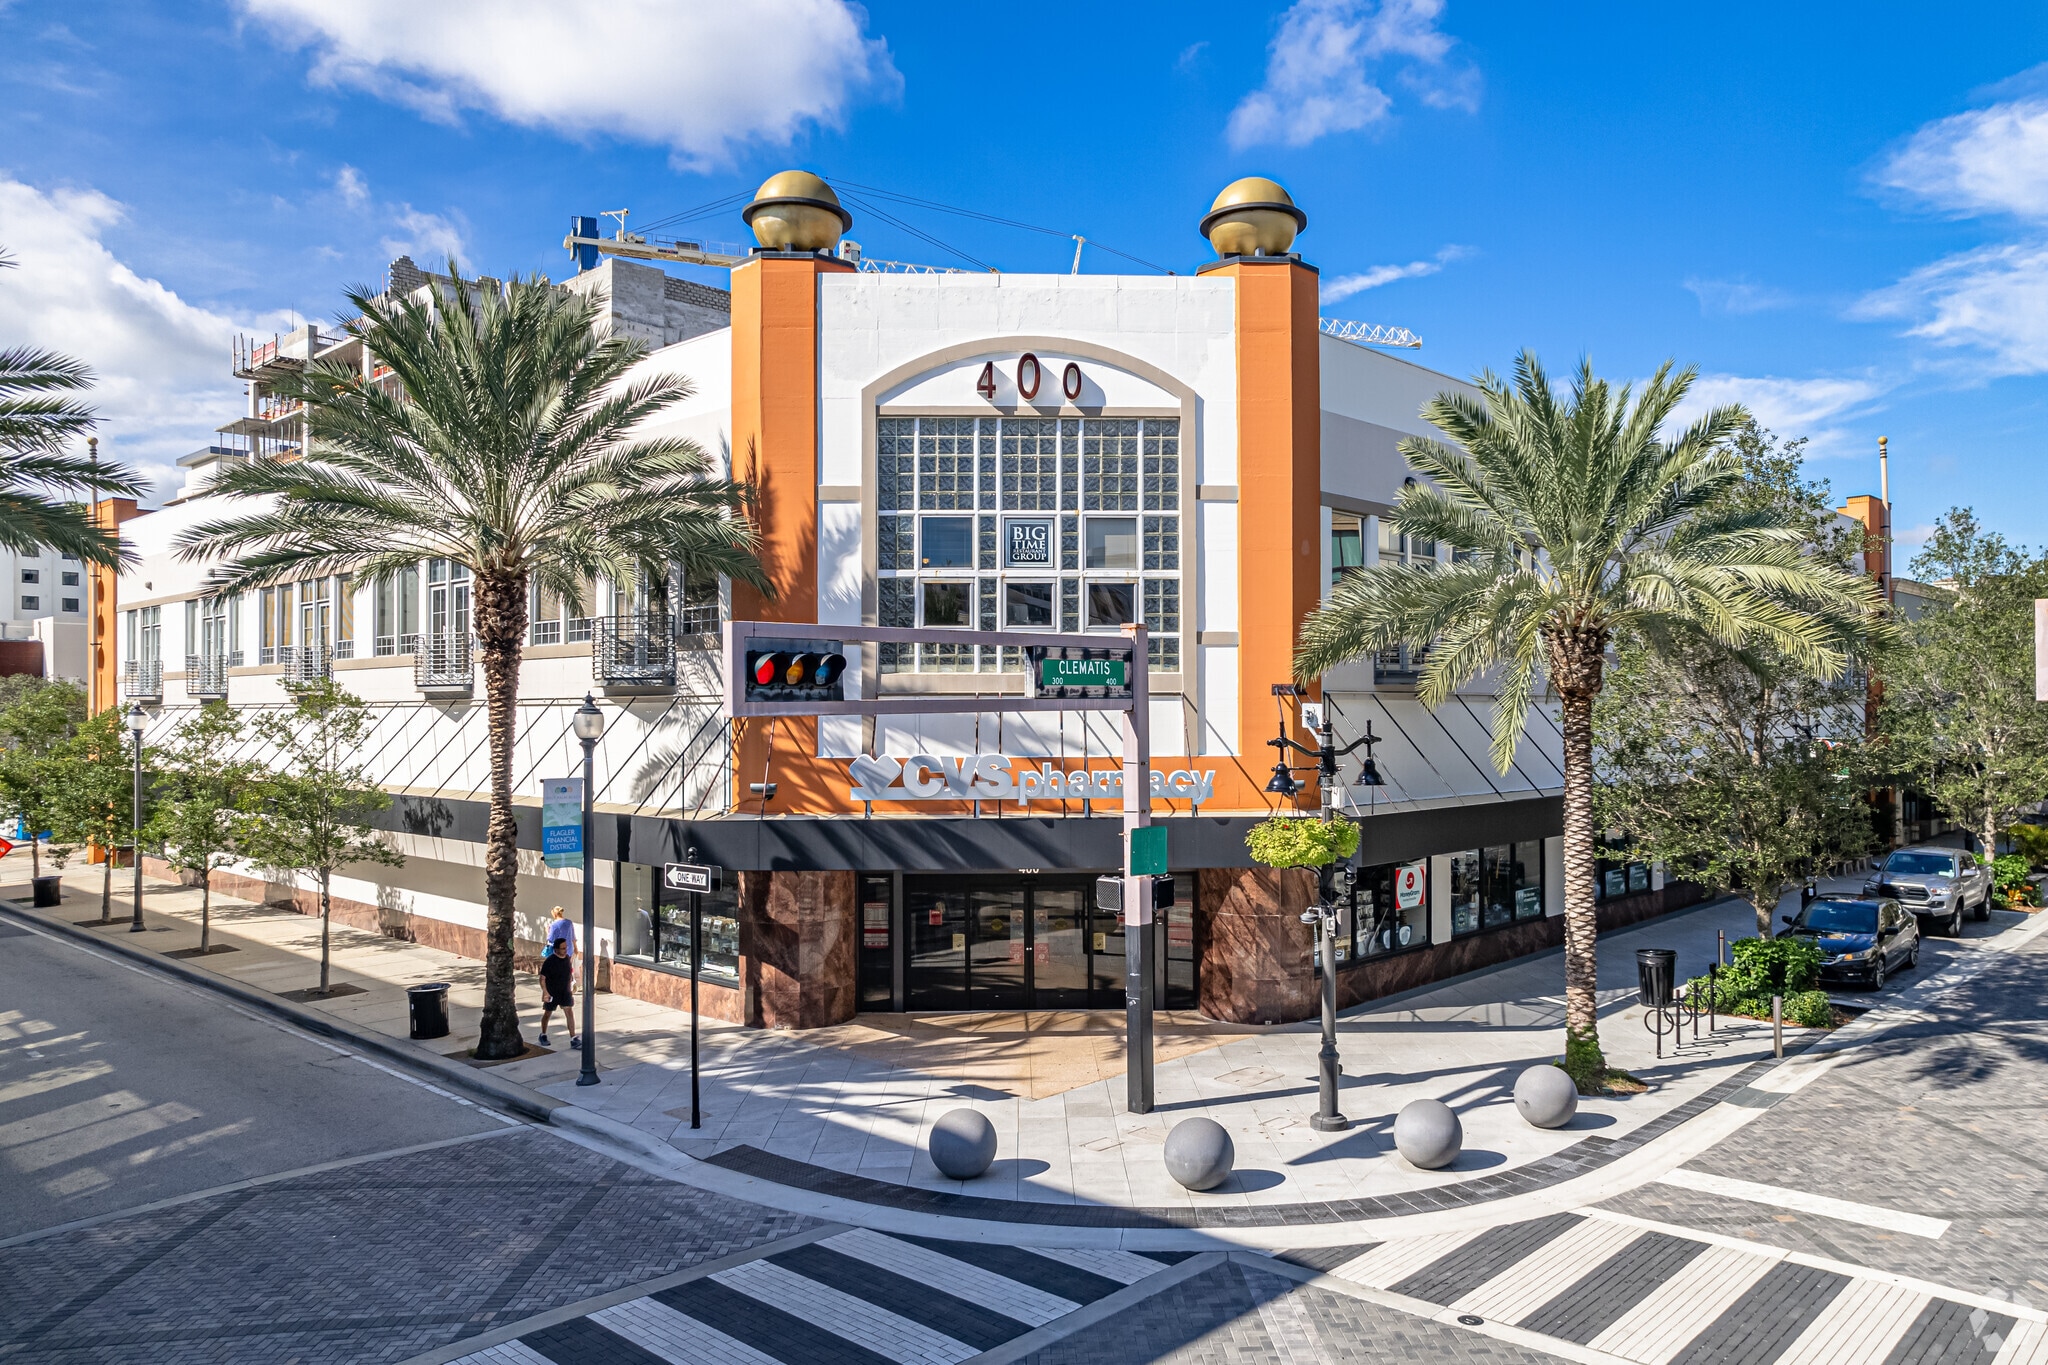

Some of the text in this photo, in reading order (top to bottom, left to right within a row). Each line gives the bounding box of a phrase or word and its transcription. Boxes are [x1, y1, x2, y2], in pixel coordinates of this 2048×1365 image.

[976, 352, 1082, 401] 400
[1012, 526, 1047, 540] BIG
[1012, 540, 1046, 549] TIME
[1058, 660, 1111, 675] CLEMATIS
[1051, 677, 1117, 686] 300 400
[903, 753, 1013, 798] CVS
[549, 828, 575, 837] FLAGLER
[546, 836, 578, 844] FINANCIAL
[549, 842, 576, 851] DISTRICT
[677, 872, 705, 884] ONE WAY
